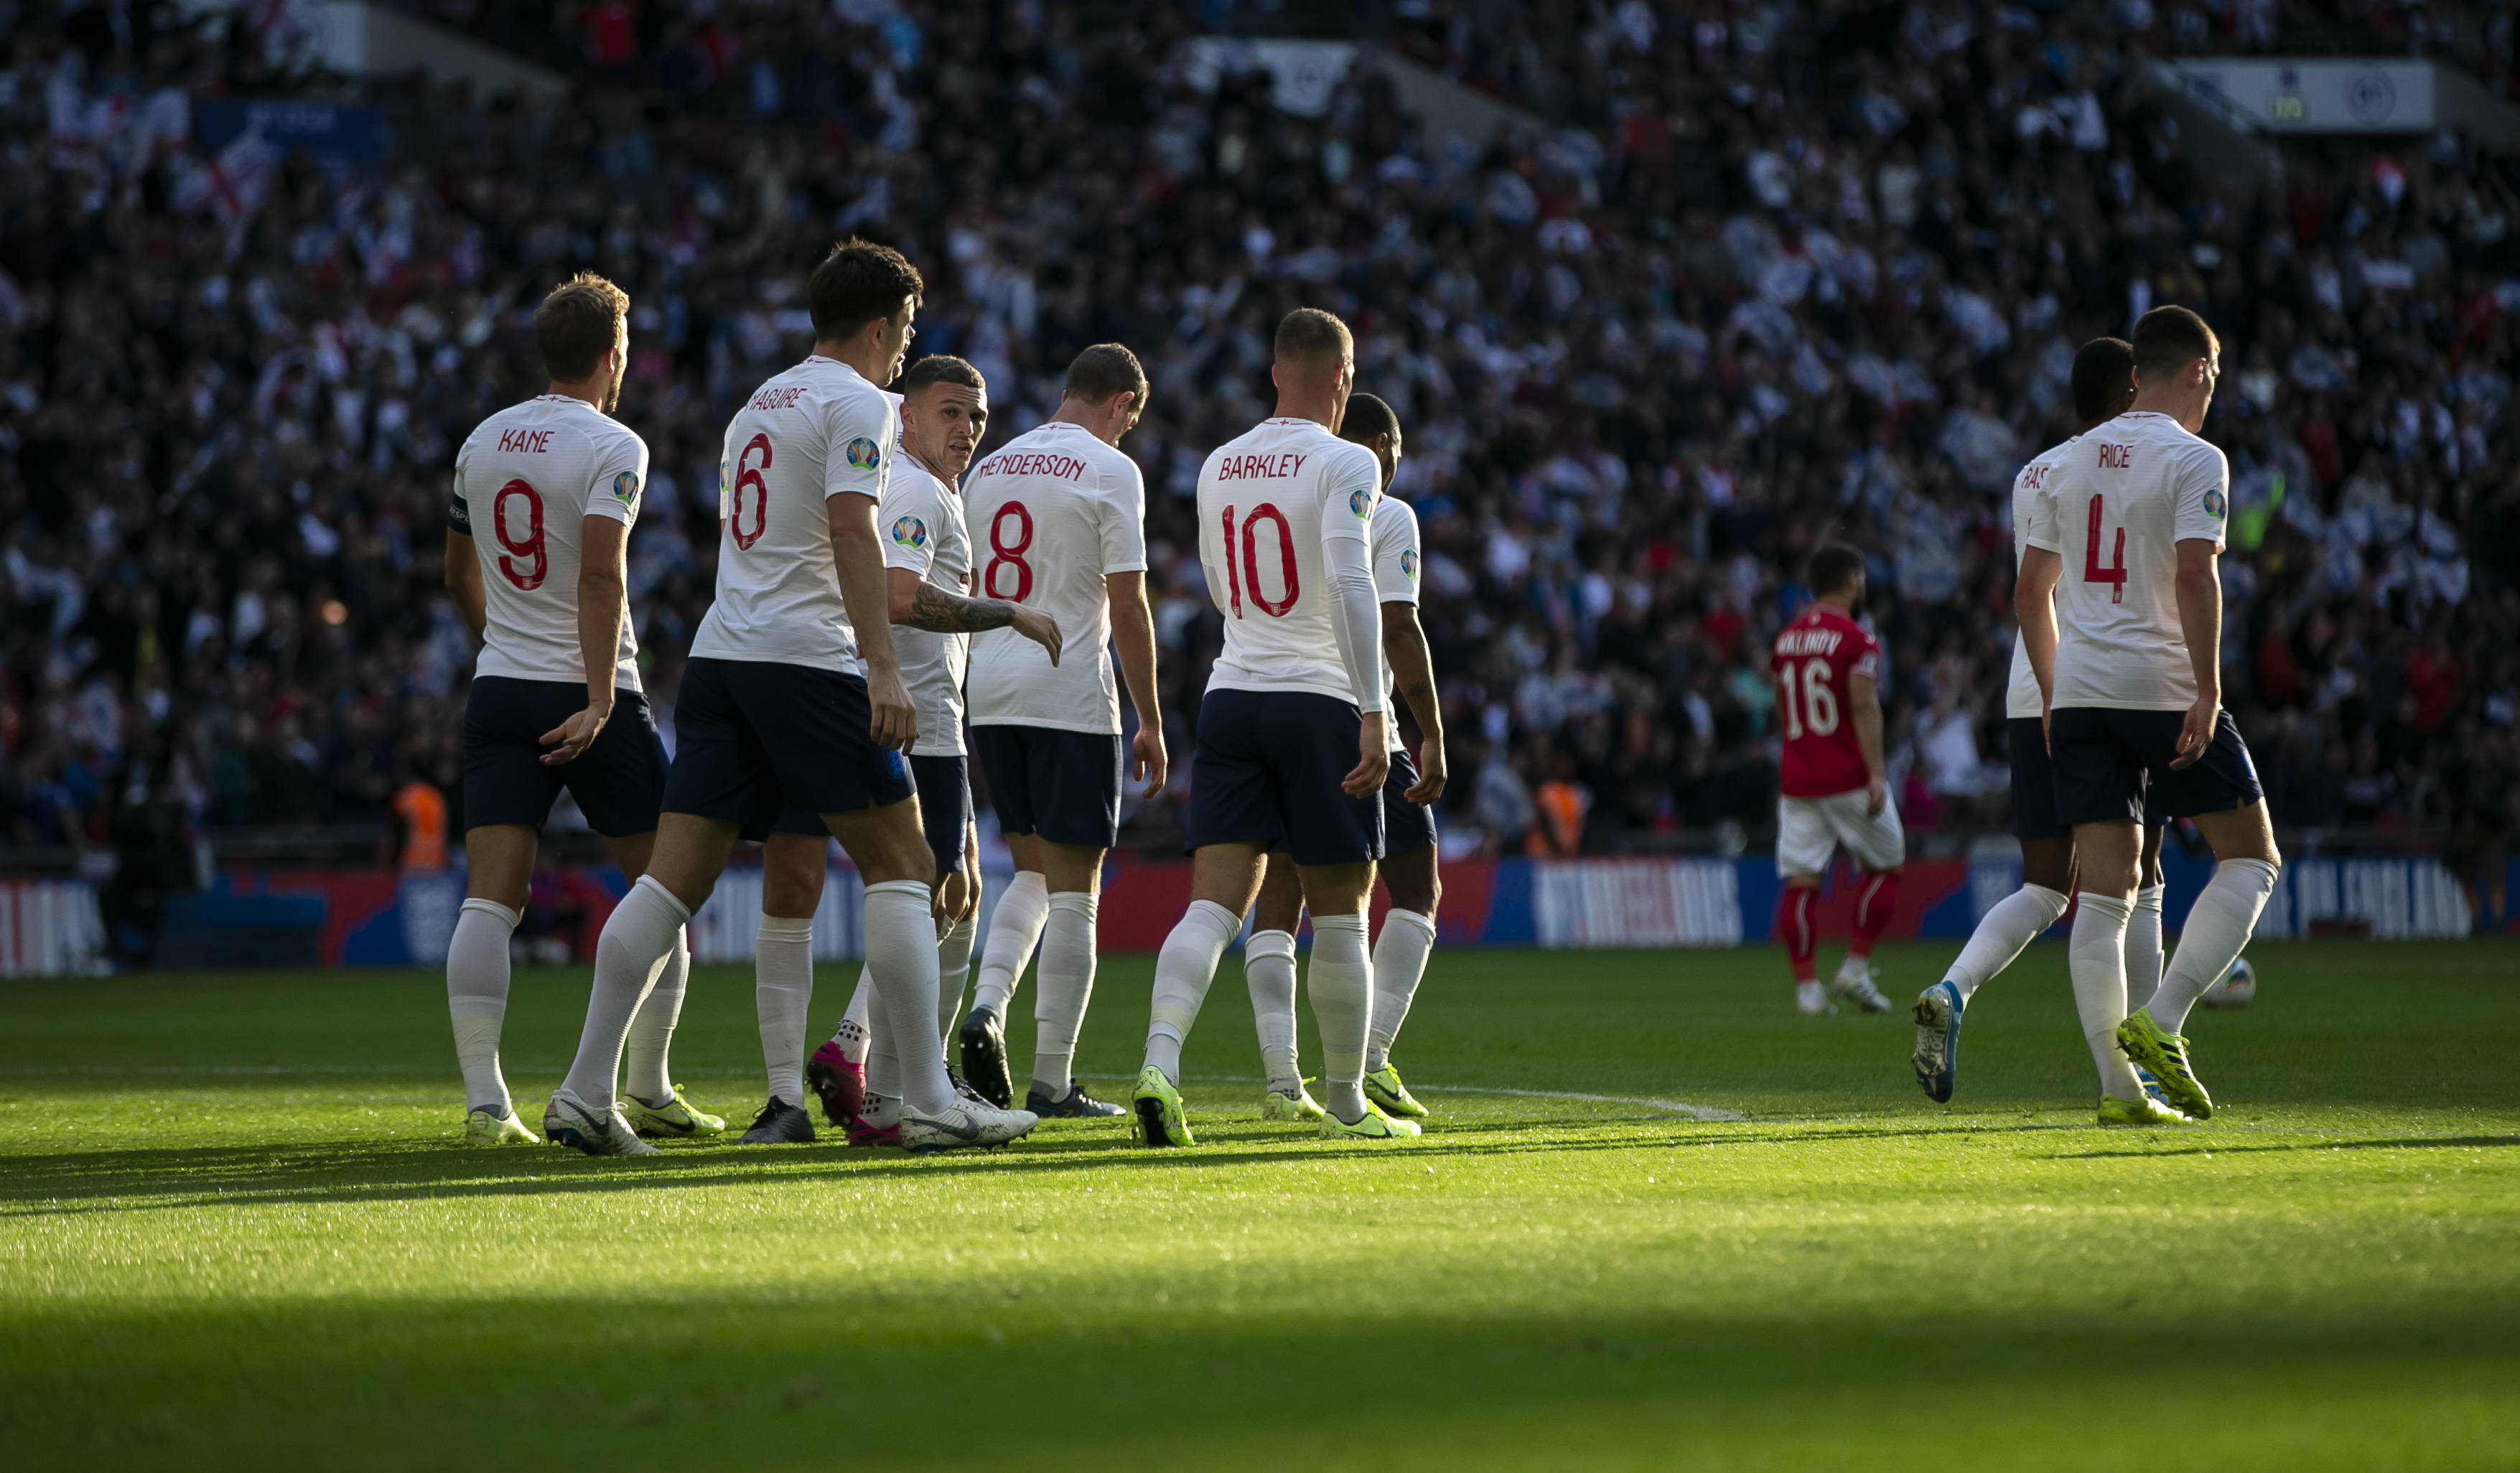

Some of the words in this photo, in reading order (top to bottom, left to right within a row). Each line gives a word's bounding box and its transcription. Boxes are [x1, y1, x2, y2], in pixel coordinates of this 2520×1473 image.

[498, 429, 555, 453] KANE
[979, 454, 1086, 482] HENDERSON
[1218, 454, 1307, 481] BARKLEY
[2099, 444, 2134, 468] RICE
[493, 479, 548, 591] 9
[732, 433, 773, 551] 6
[984, 500, 1034, 603] 8
[1222, 502, 1300, 620] 10
[2083, 493, 2128, 604] 4
[1781, 658, 1839, 739] 16
